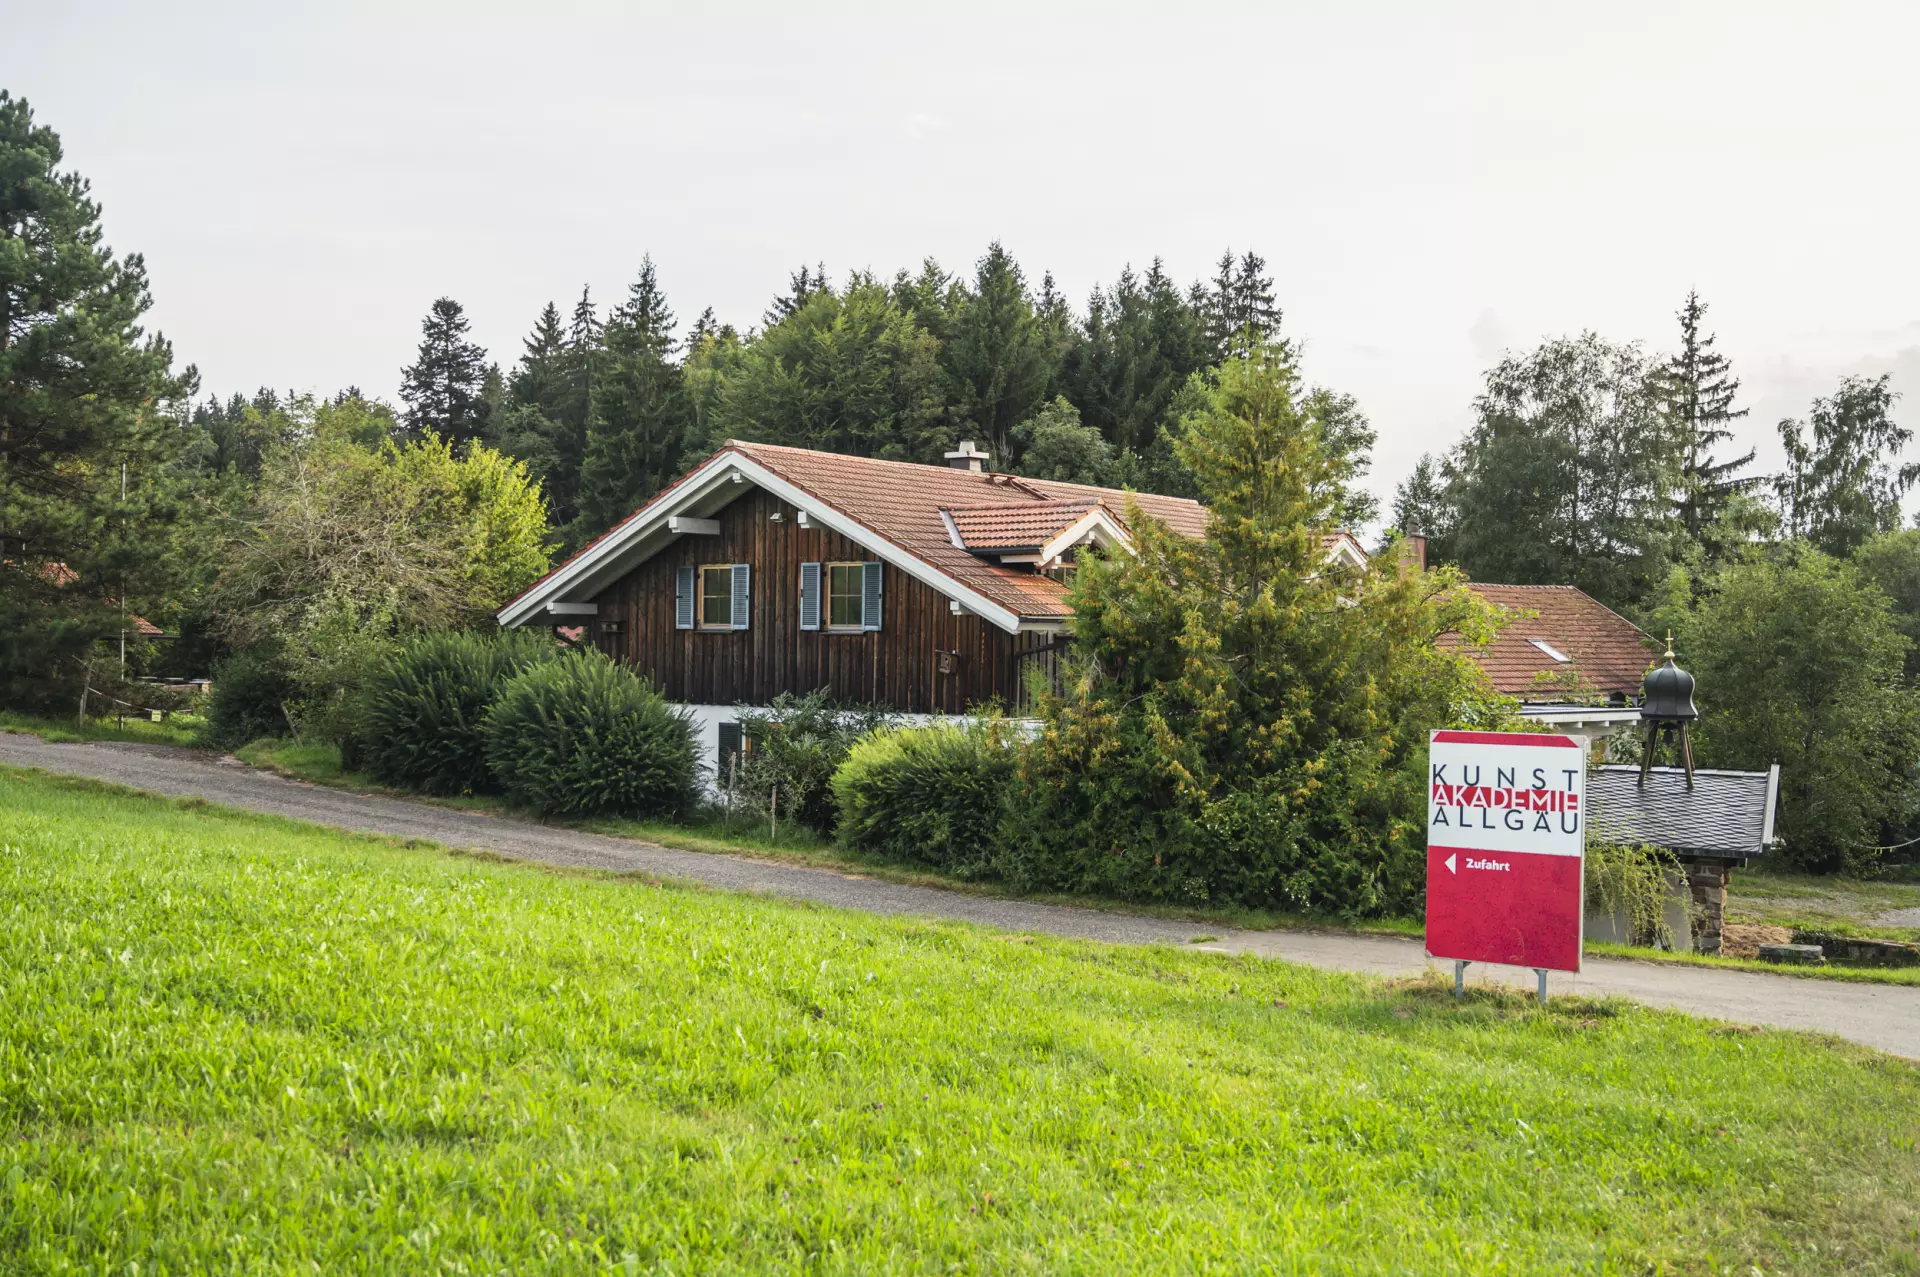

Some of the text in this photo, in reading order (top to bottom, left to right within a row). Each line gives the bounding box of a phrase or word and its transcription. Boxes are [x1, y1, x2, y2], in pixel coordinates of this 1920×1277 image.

[1433, 763, 1578, 791] KUNST
[1433, 784, 1578, 812] AKADEMIE
[1432, 805, 1578, 834] ALLGÄU
[1466, 858, 1510, 872] Zufahrt
